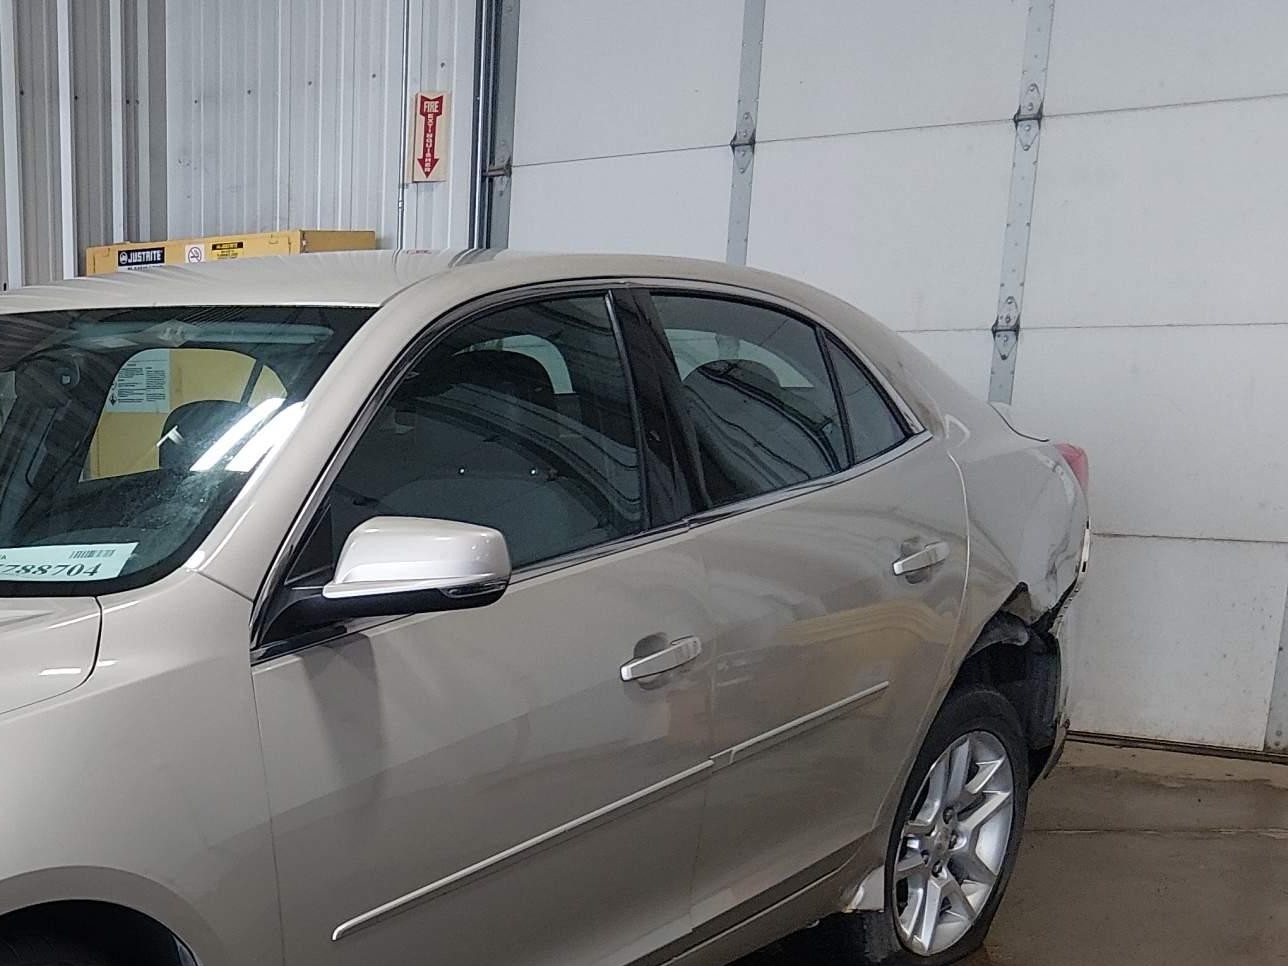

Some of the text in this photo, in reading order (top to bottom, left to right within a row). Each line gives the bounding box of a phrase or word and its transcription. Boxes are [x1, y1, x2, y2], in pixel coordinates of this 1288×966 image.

[424, 101, 439, 113] FIRE
[424, 113, 434, 173] EXTINGUISHER
[127, 249, 162, 263] JUSTRITE
